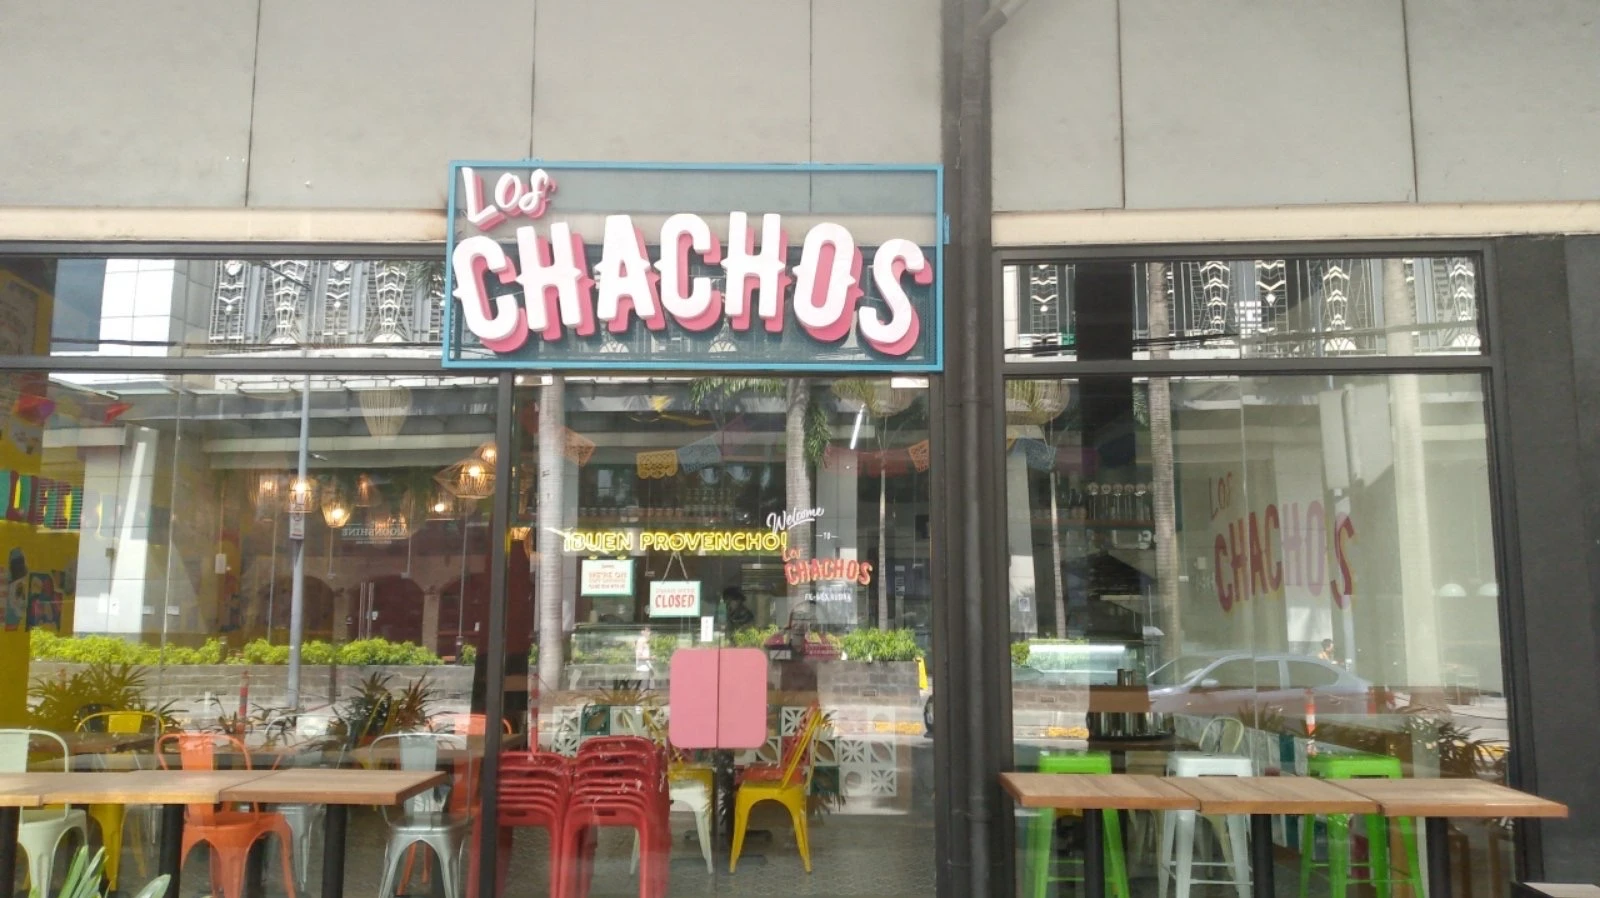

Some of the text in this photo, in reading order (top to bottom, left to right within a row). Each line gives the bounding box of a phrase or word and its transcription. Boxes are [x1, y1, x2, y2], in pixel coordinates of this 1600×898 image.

[460, 166, 558, 231] LOS
[452, 211, 933, 356] CHACHOS
[766, 507, 825, 535] Welcome
[639, 532, 788, 552] PROVENCHO!
[1214, 500, 1355, 613] CHACHOS
[784, 558, 873, 586] CHACHOS
[655, 594, 695, 609] CLOSED
